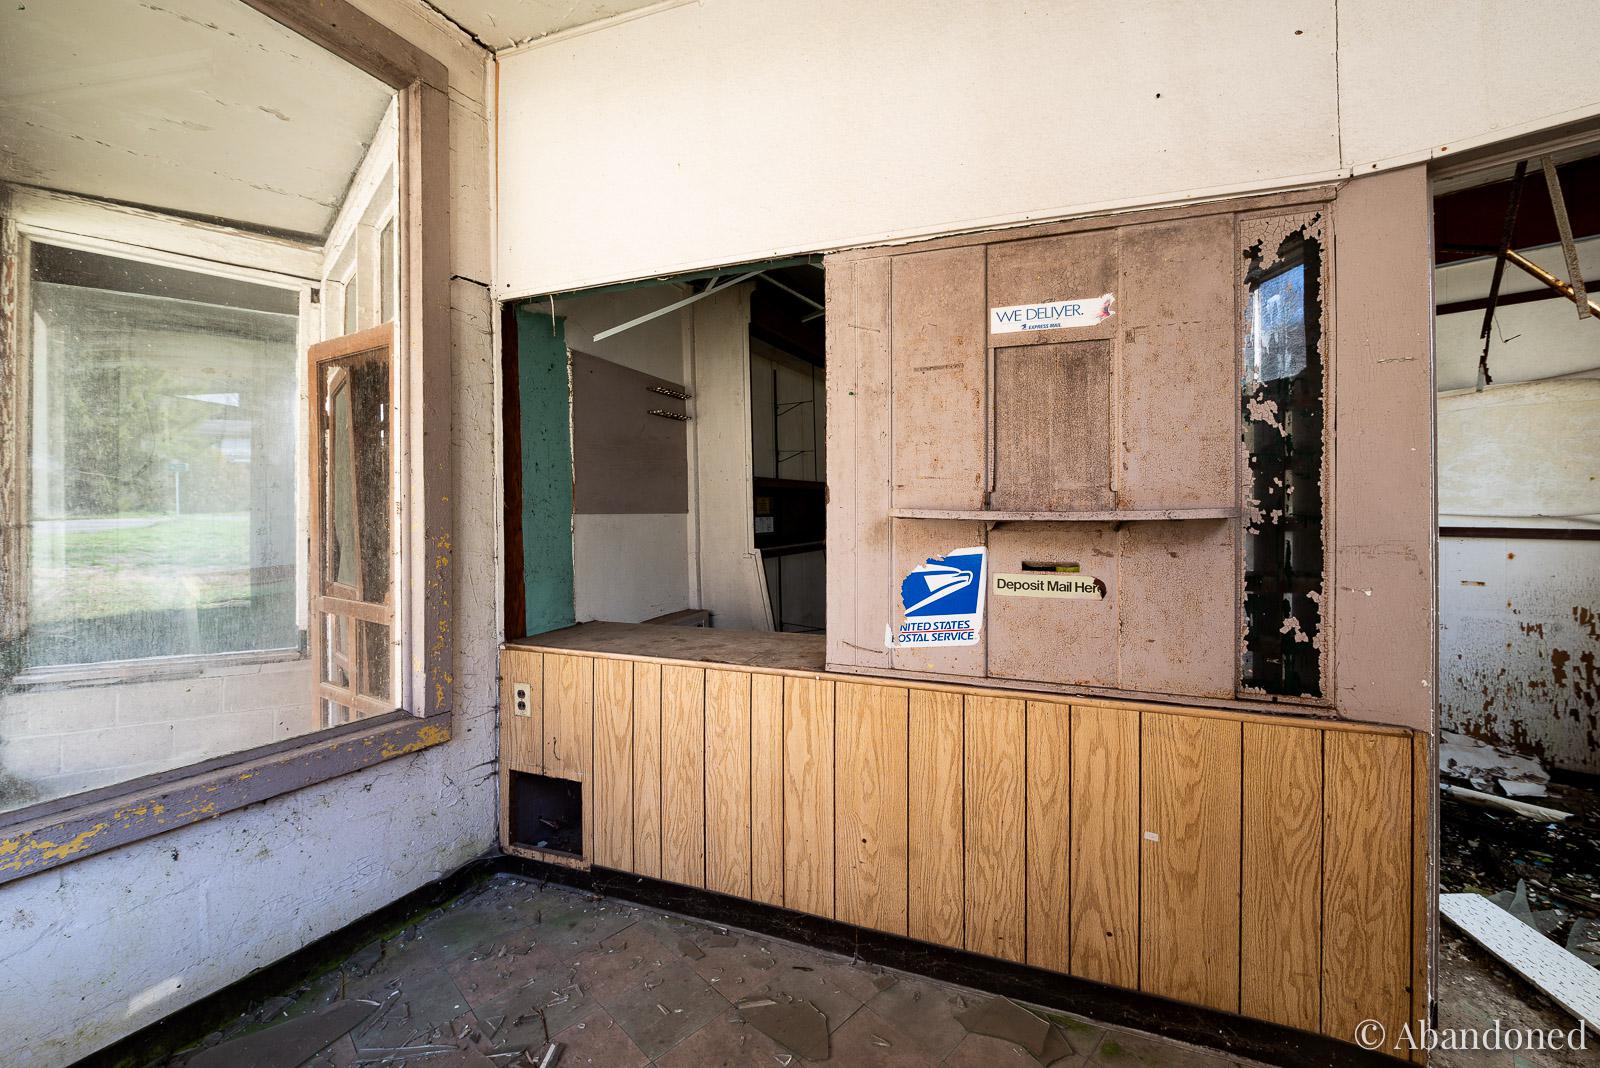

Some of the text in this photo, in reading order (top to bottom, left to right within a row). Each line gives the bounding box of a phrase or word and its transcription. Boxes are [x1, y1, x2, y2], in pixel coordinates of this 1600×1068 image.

[995, 304, 1084, 323] WE DELIVER.
[997, 578, 1045, 593] Deposit
[1047, 580, 1072, 593] Mail
[899, 619, 970, 632] NITED STATES
[891, 631, 975, 643] OSTAL SERVICE
